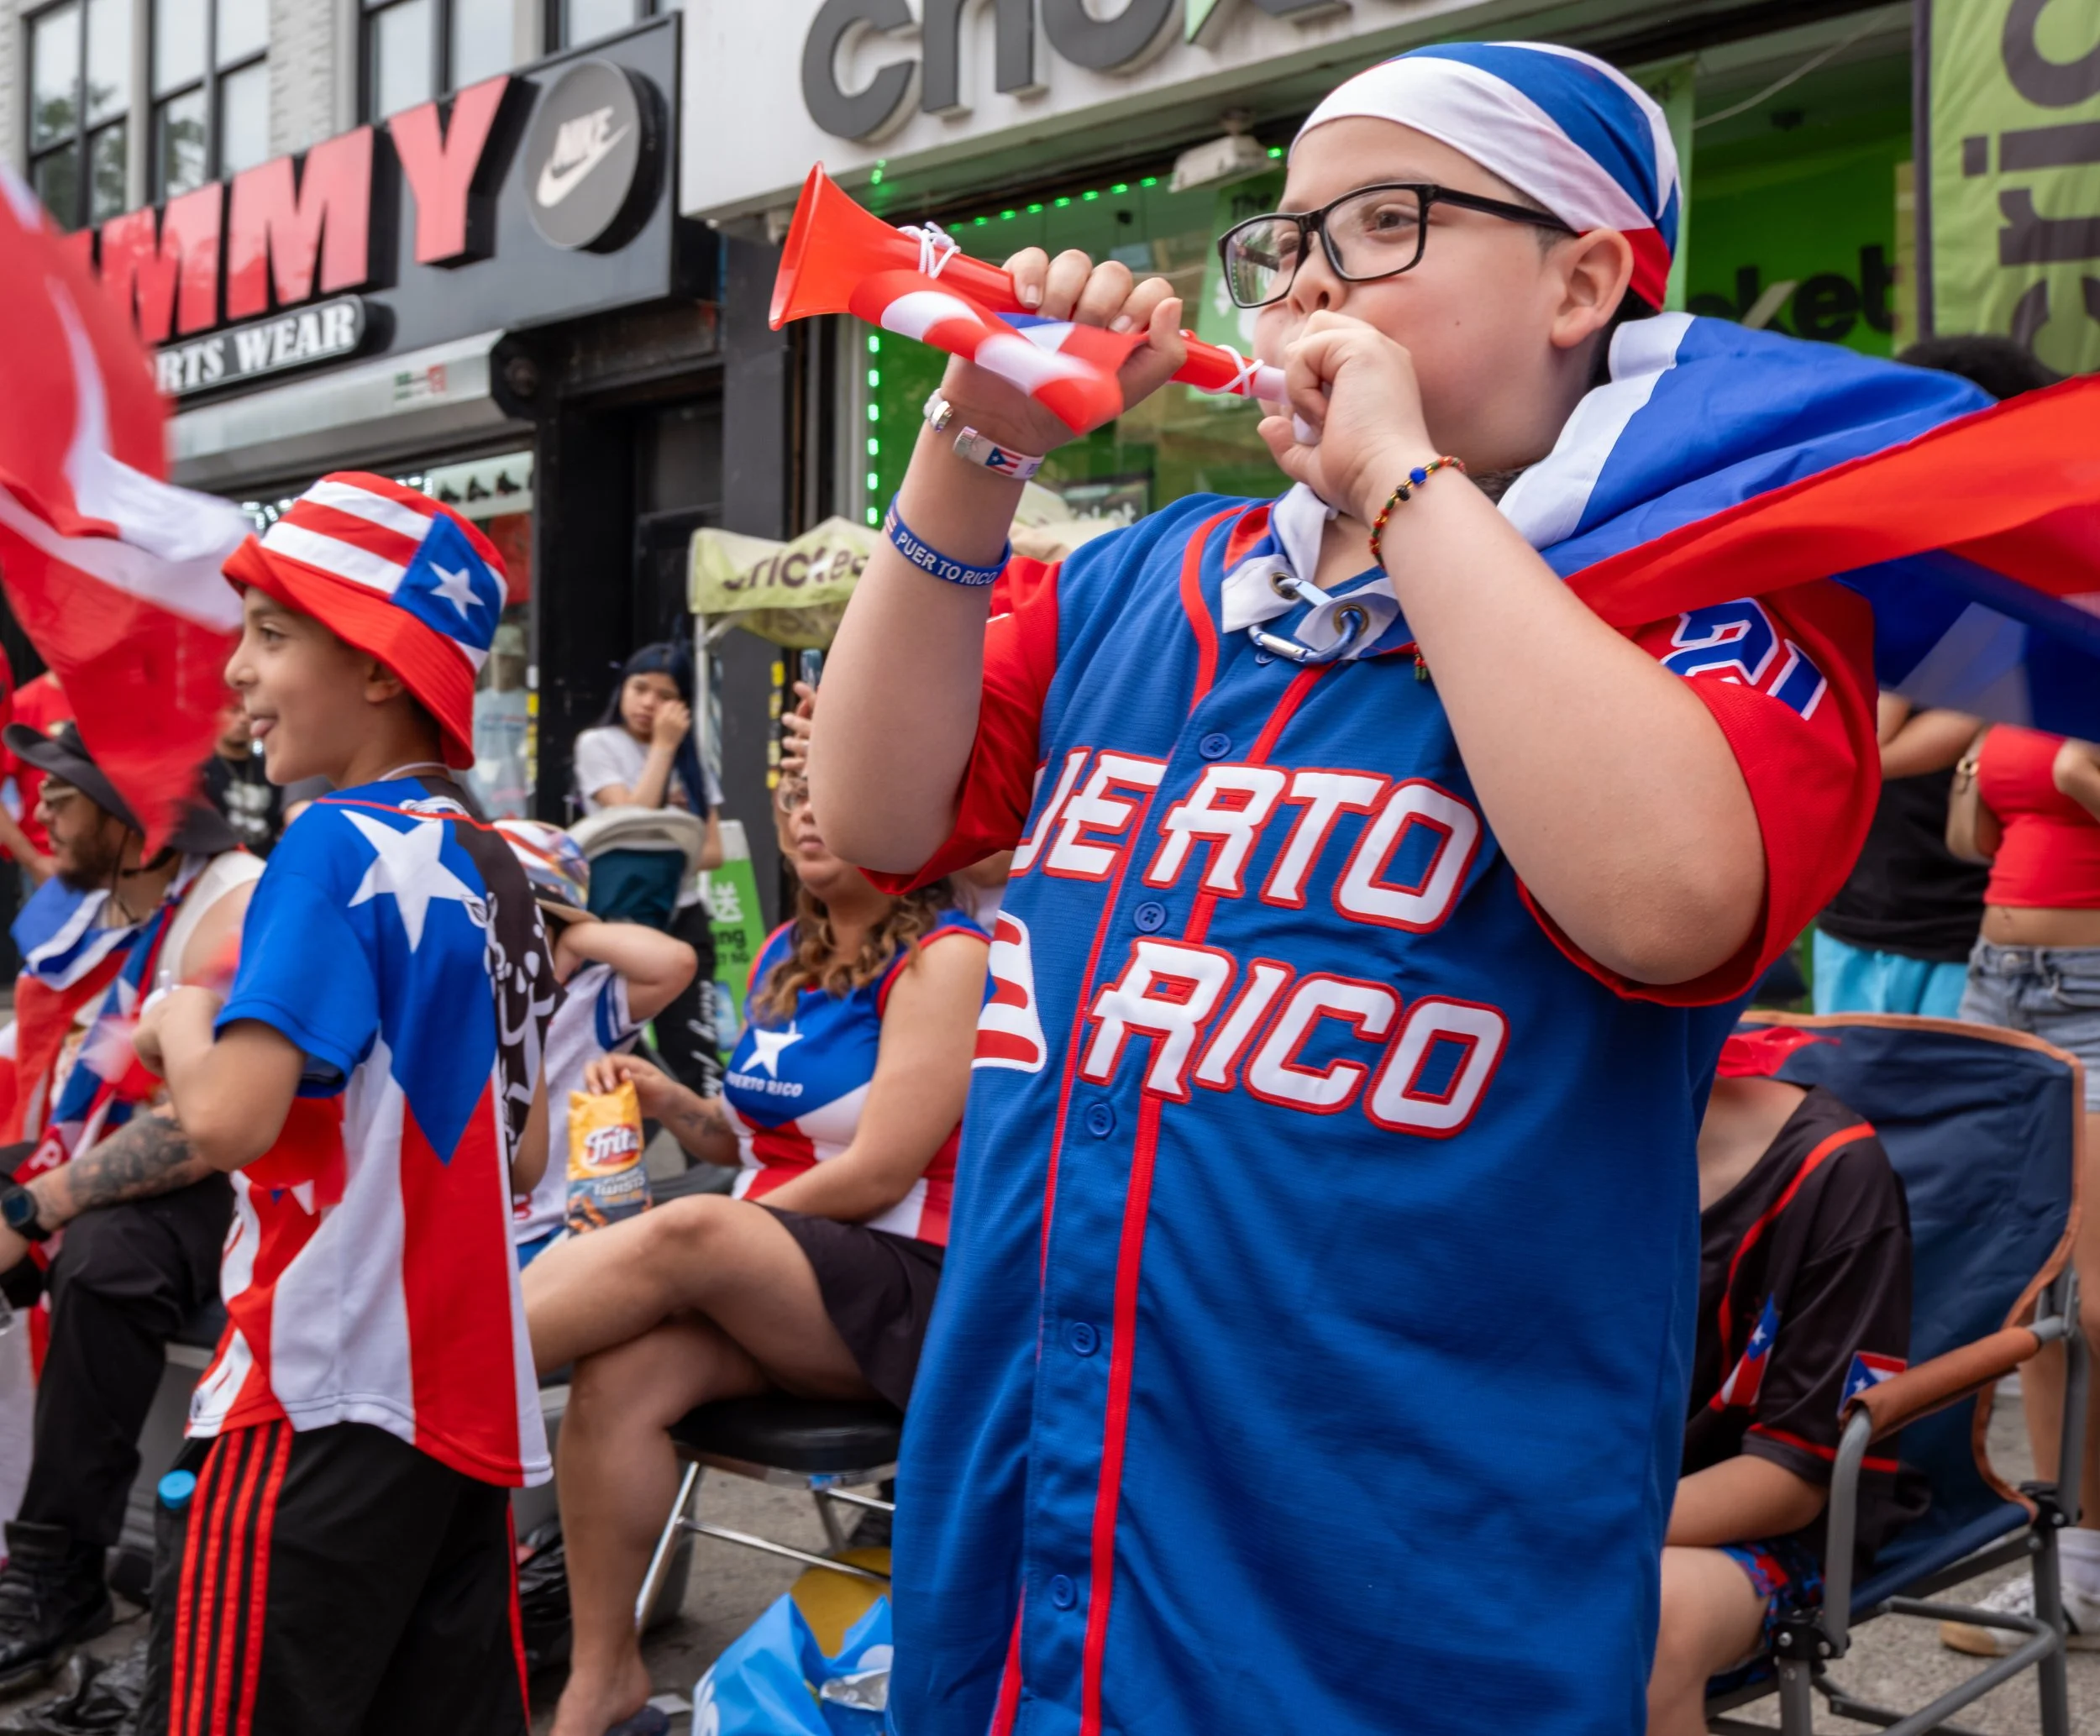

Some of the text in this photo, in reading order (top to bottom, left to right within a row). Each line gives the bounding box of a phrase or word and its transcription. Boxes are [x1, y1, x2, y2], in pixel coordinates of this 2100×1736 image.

[59, 74, 511, 344] MMY
[1687, 243, 1903, 340] ket
[150, 303, 357, 395] RTS WEAR
[722, 545, 871, 591] ricke
[964, 573, 1006, 588] RICO
[1078, 936, 1510, 1139] RICO
[765, 1078, 804, 1099] RICO
